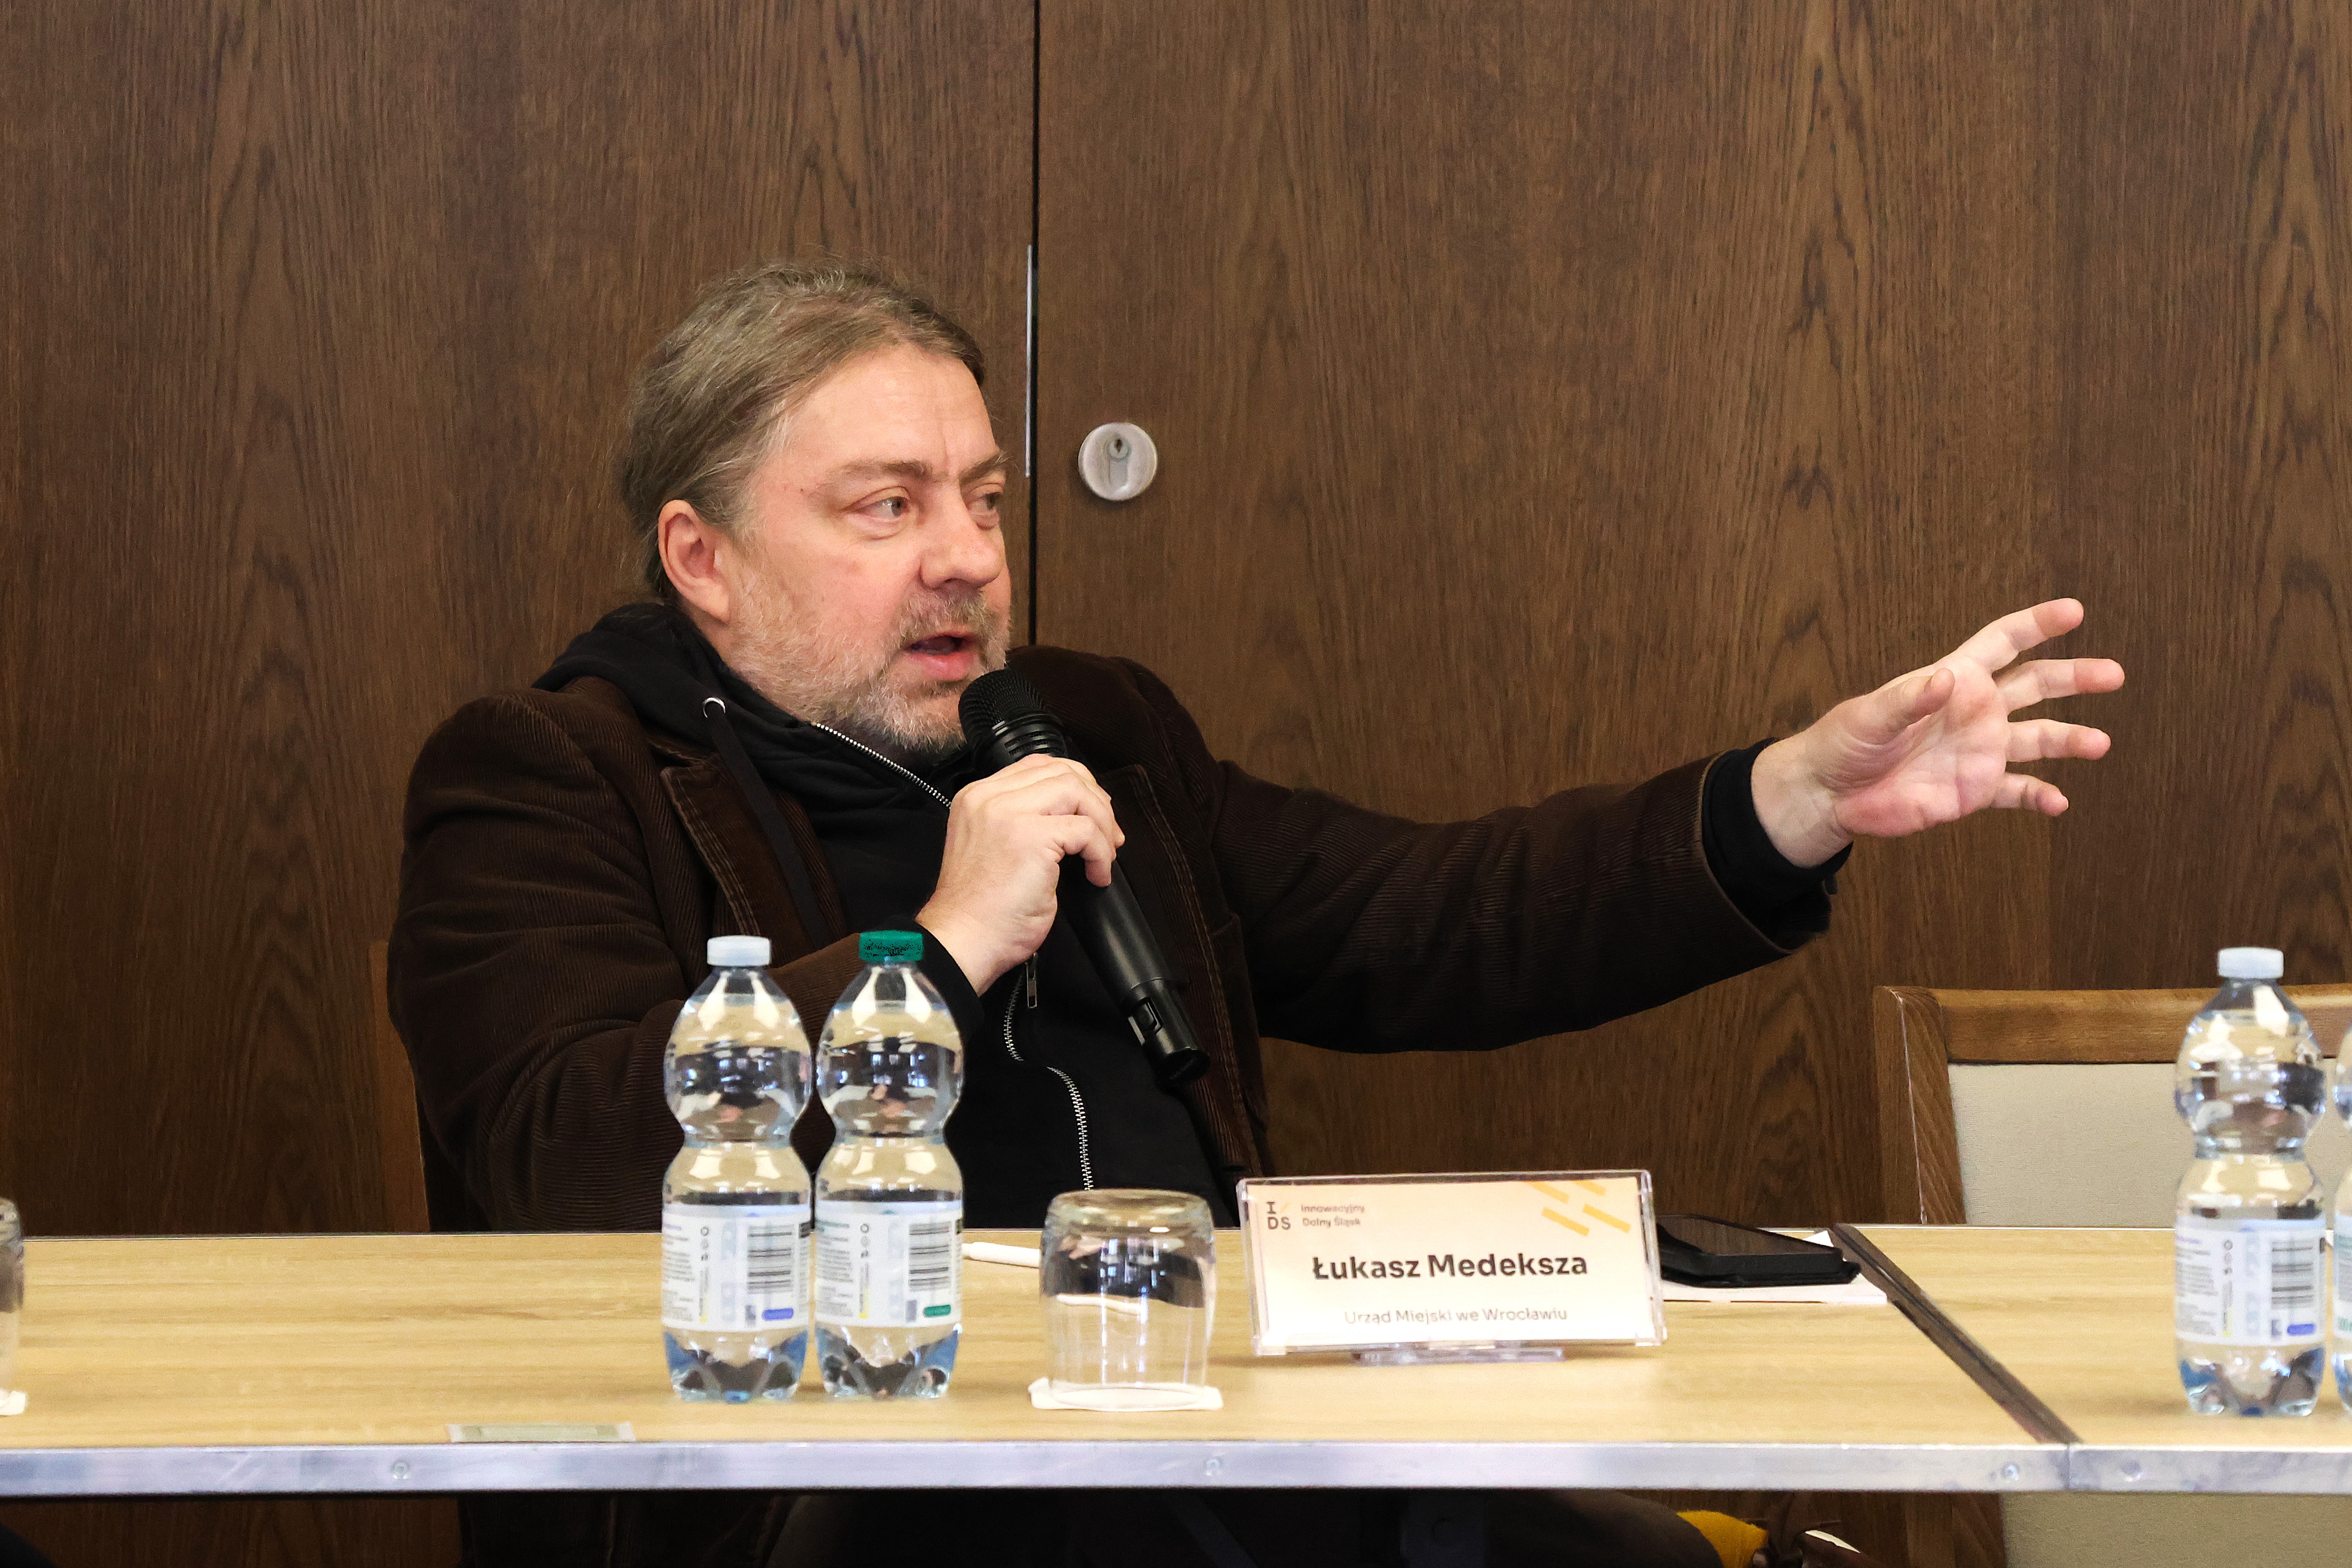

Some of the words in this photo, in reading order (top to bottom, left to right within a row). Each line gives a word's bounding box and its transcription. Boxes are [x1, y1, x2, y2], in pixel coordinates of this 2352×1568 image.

[1267, 1217, 1291, 1230] DS
[1312, 1256, 1421, 1280] Łukasz
[1427, 1253, 1588, 1278] Medeksza
[1345, 1310, 1392, 1326] Urząd
[1395, 1309, 1453, 1325] Miejski
[1456, 1311, 1479, 1322] we
[1482, 1308, 1568, 1321] Wrocławiu
